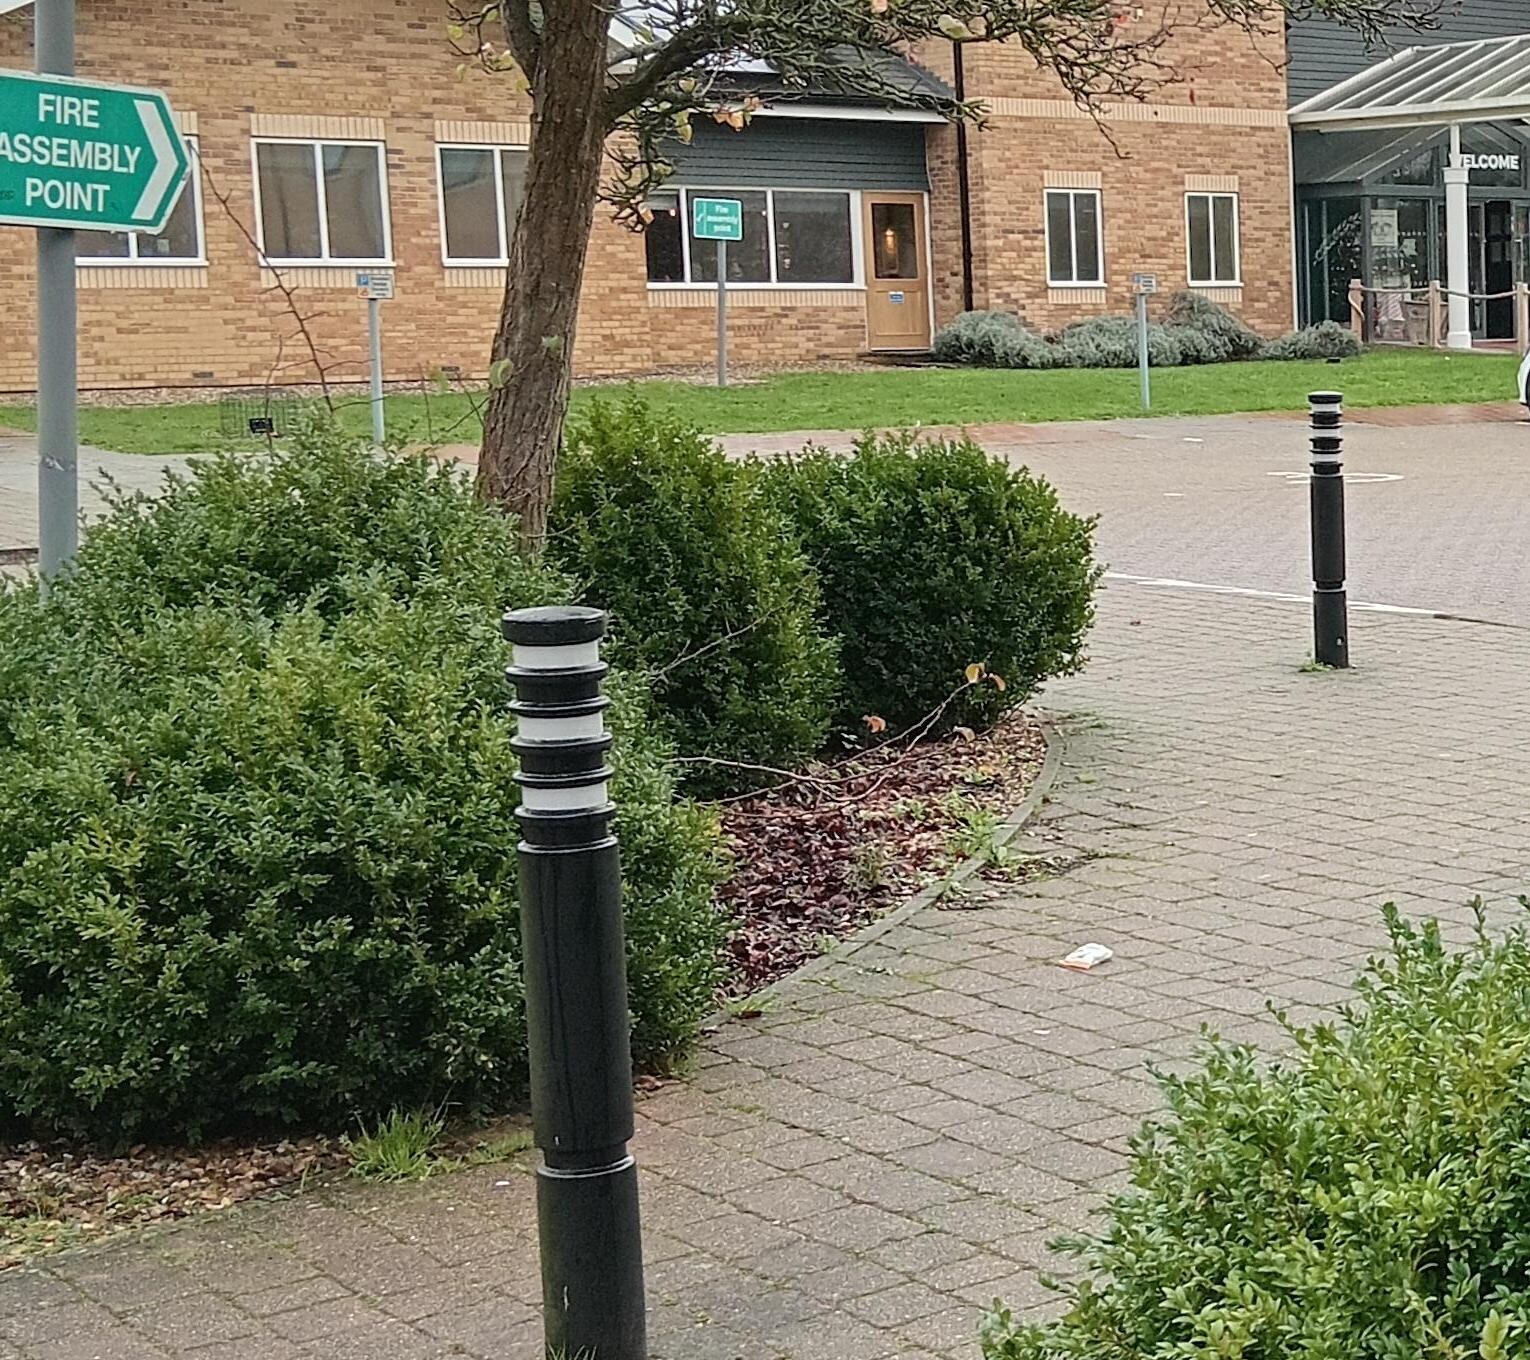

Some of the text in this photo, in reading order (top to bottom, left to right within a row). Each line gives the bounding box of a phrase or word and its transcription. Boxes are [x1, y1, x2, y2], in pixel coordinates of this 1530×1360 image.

[38, 93, 100, 129] FIRE
[0, 131, 141, 174] ASSEMBLY
[25, 177, 111, 213] POINT
